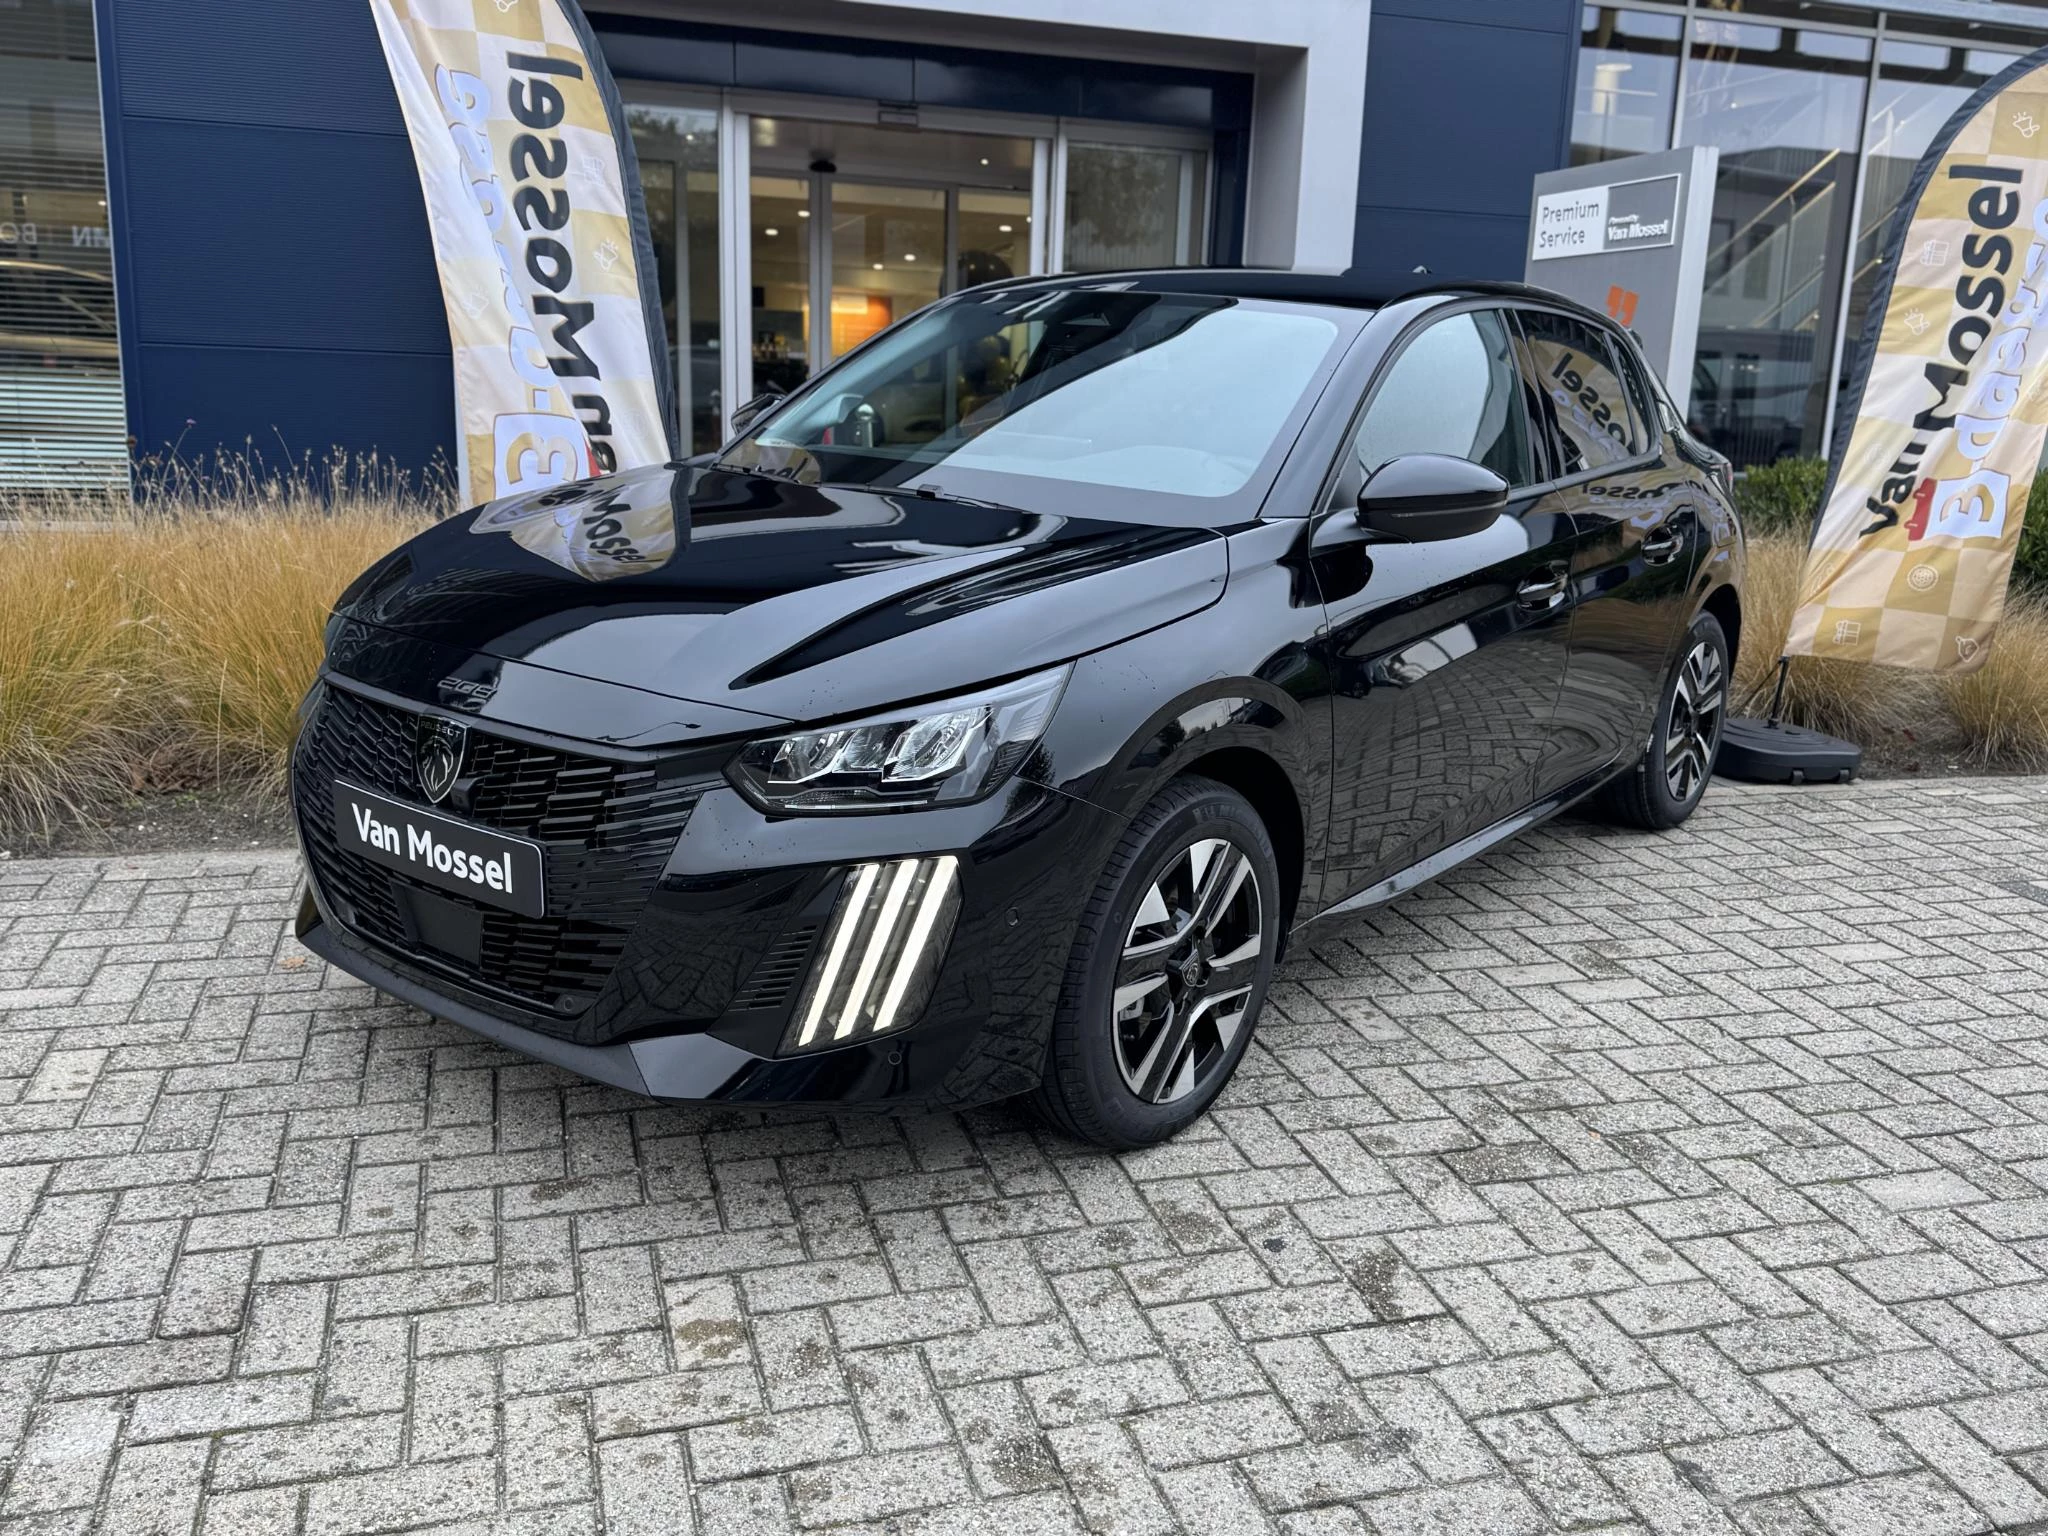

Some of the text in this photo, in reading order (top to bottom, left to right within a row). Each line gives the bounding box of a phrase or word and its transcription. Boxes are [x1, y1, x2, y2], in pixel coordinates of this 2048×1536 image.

[1542, 201, 1600, 224] Premium
[1539, 227, 1585, 248] Service
[1608, 219, 1669, 240] Van Mossel
[1858, 164, 2023, 539] Van Mossel
[437, 676, 498, 699] 208
[351, 802, 513, 894] Van Mossel
